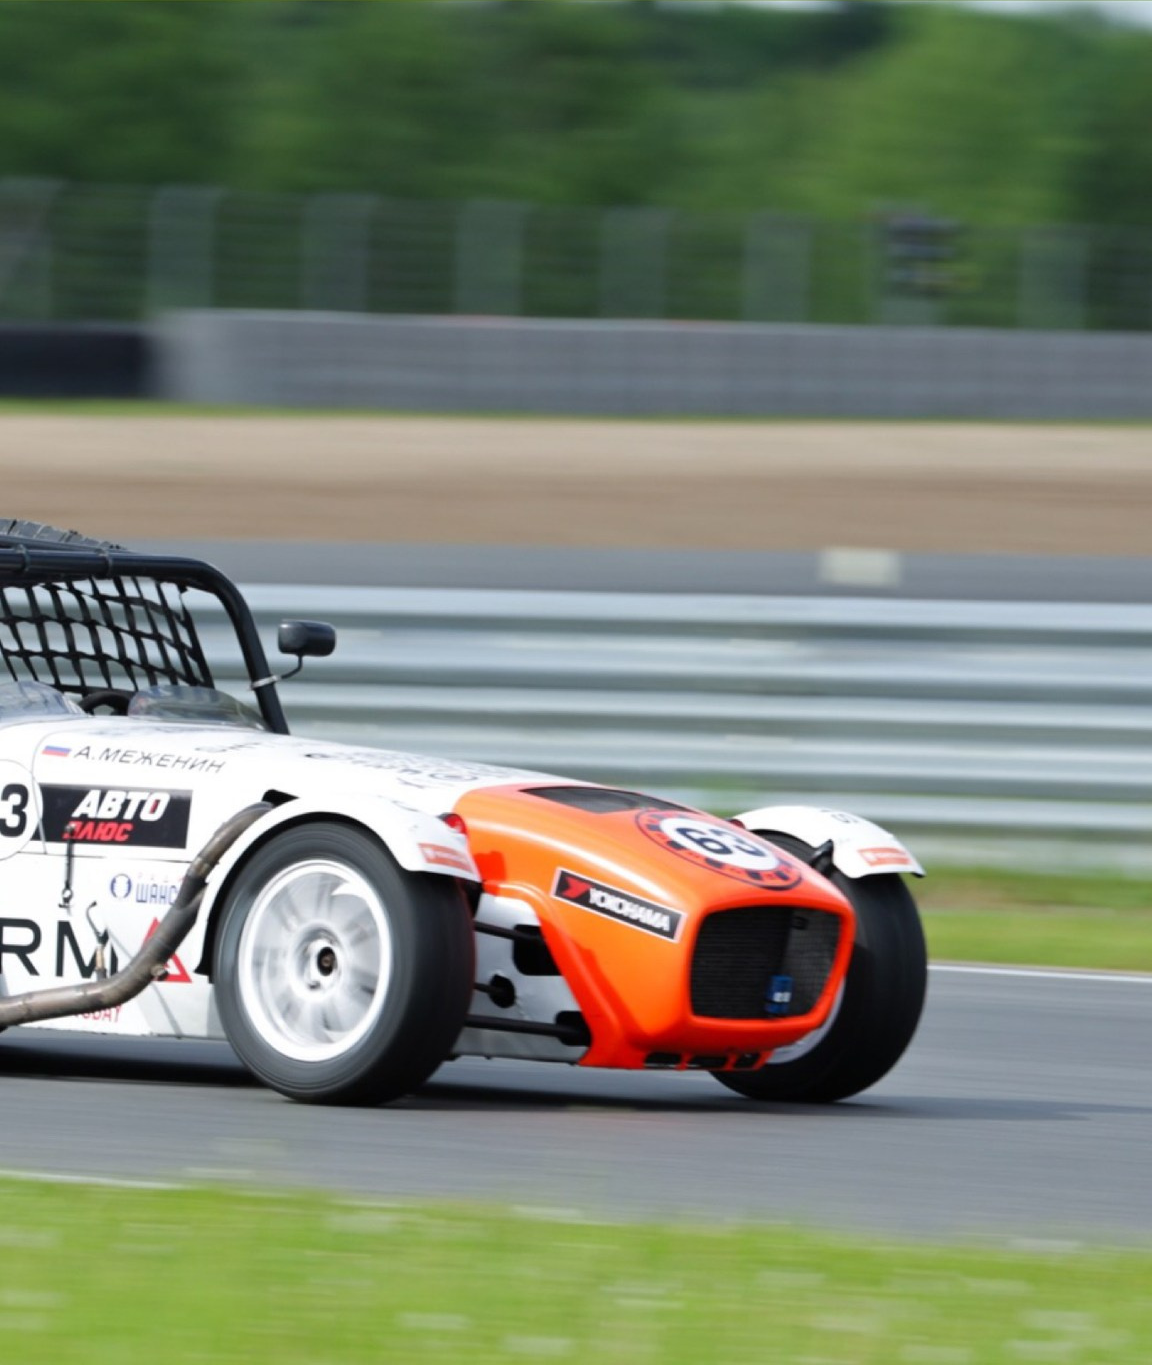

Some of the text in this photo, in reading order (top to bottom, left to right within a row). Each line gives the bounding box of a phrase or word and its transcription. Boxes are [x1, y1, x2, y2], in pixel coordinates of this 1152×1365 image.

[74, 746, 226, 774] А.МЕЖЕНИН
[71, 789, 170, 821] АВТО
[62, 821, 133, 841] ПЛЮС
[675, 827, 767, 858] 63
[136, 883, 179, 906] ШАНС
[589, 887, 670, 932] YOKOHAMA
